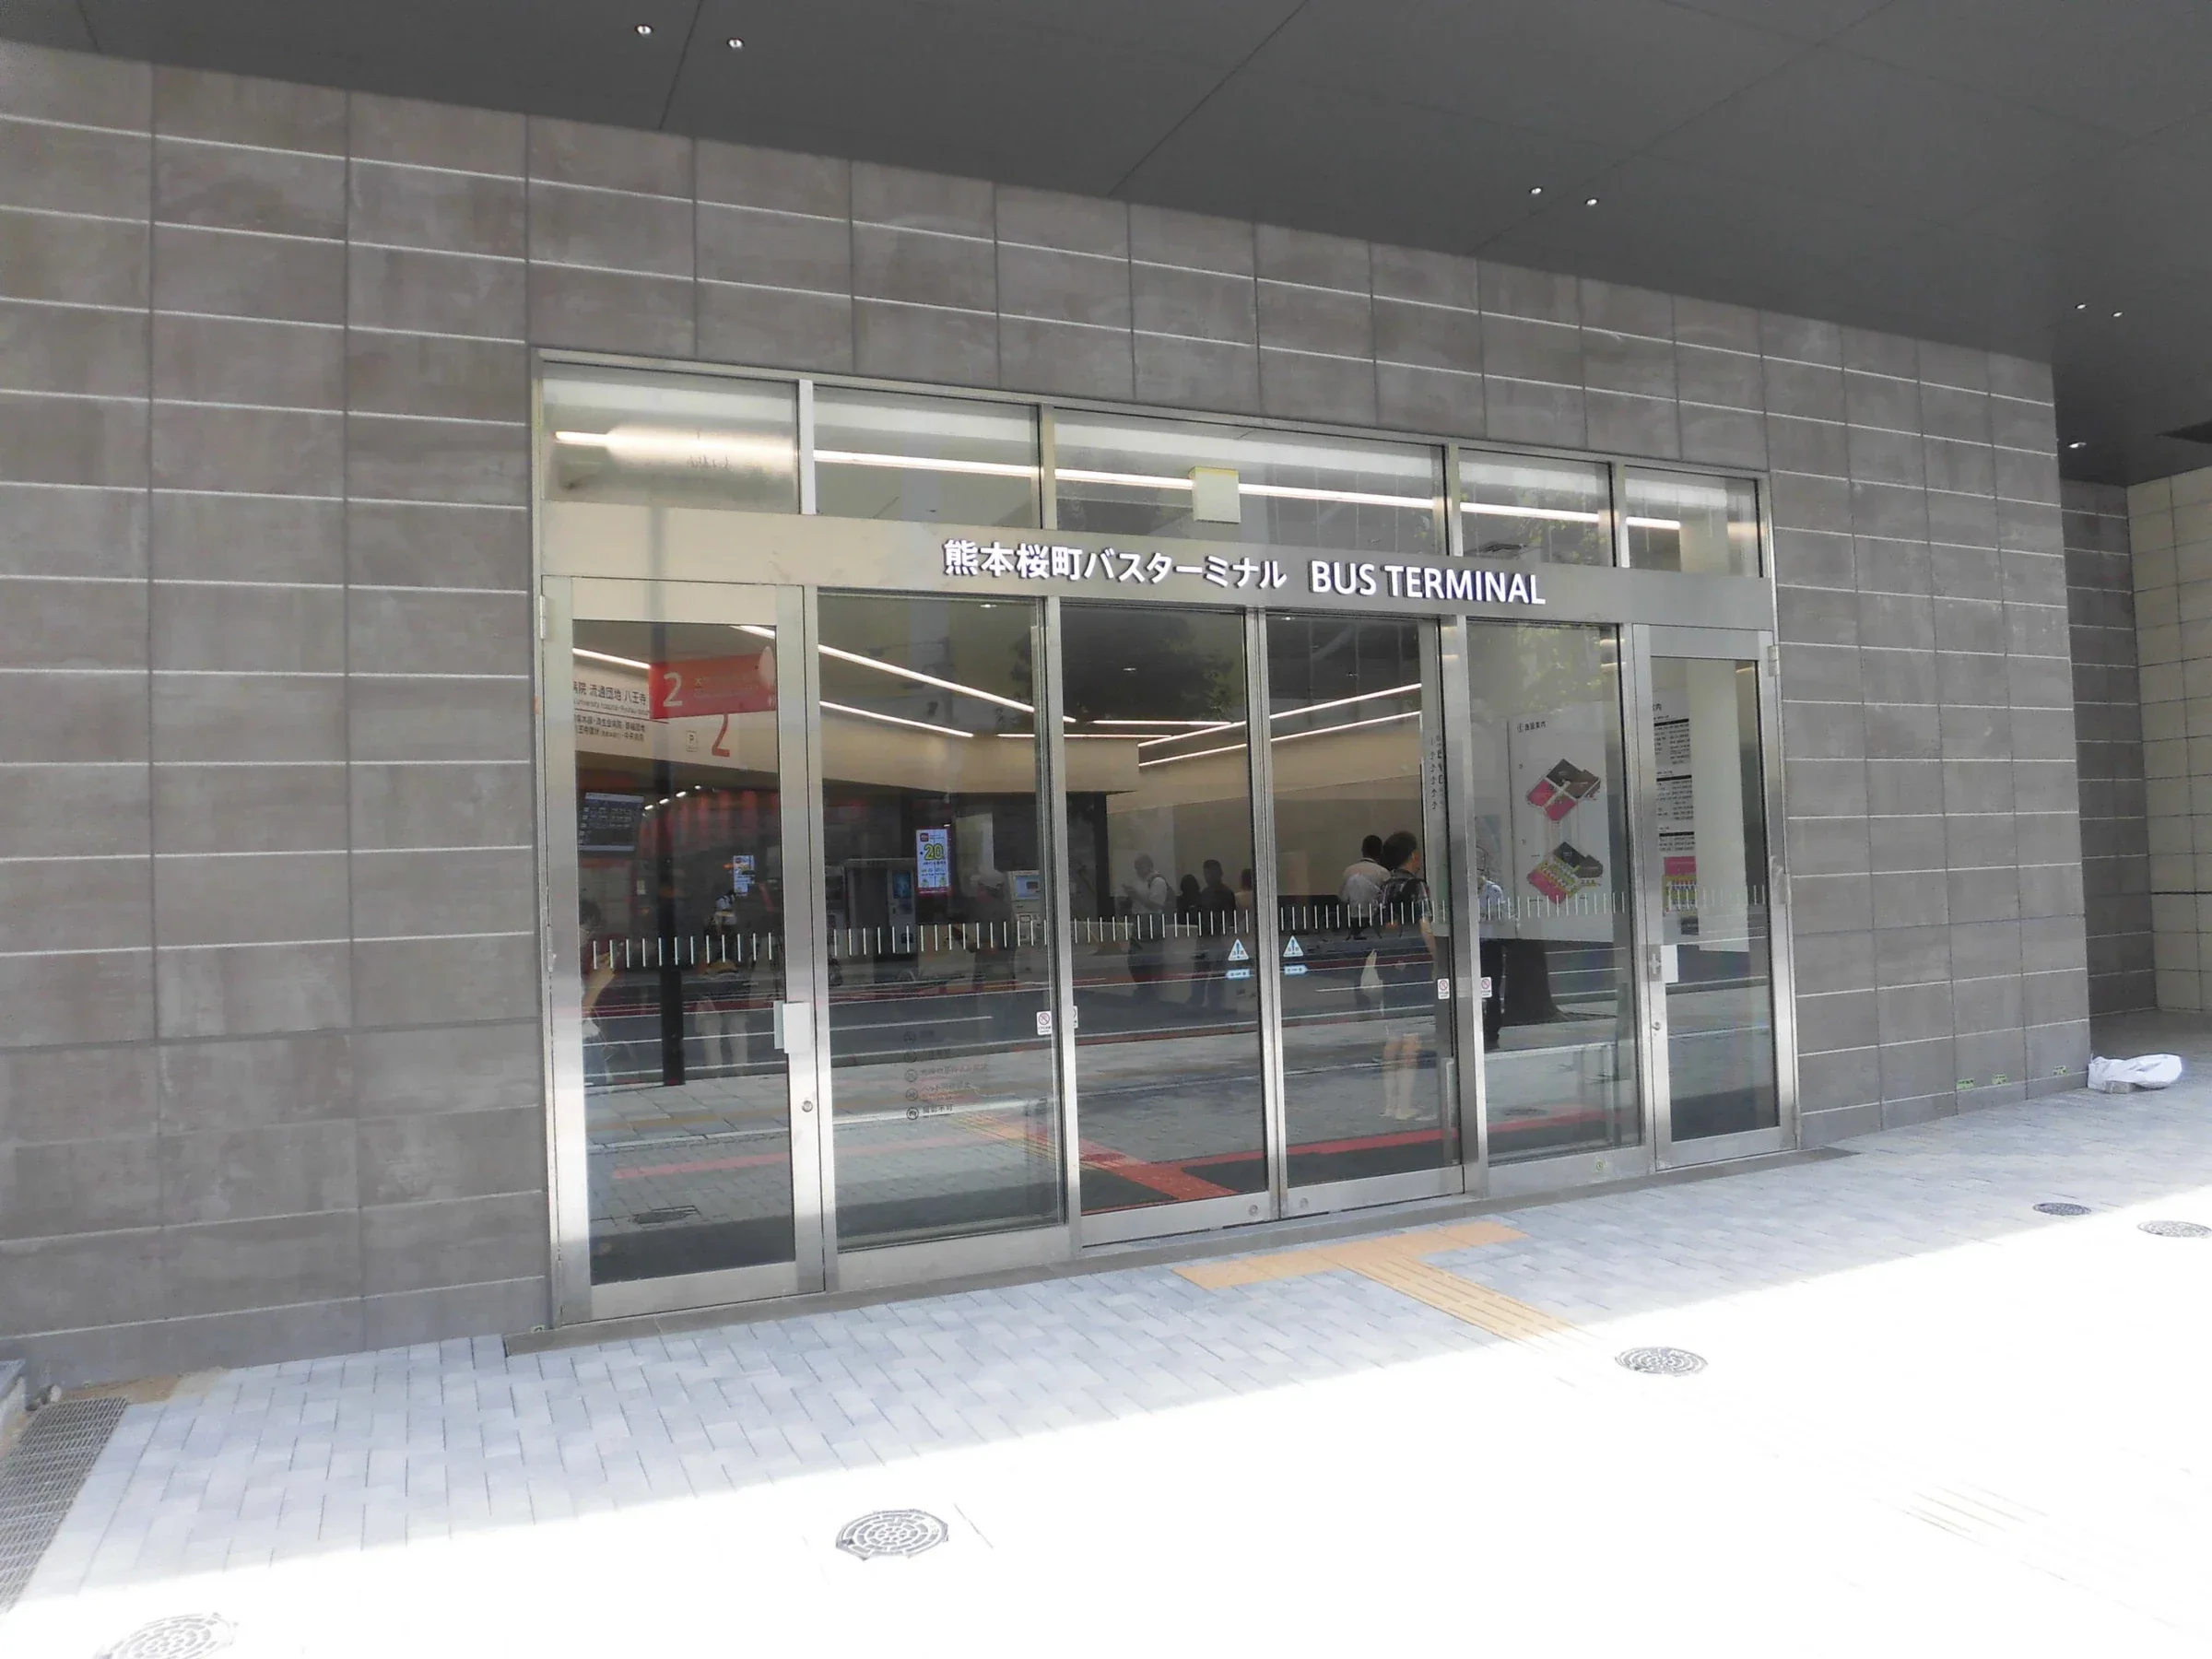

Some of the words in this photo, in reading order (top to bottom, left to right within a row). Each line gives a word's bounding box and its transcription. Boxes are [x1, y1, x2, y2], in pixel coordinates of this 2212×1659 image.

[943, 539, 1287, 588] 熊本桜町バスターミナル
[1311, 560, 1377, 595] BUS
[1383, 565, 1547, 605] TERMINAL
[664, 672, 683, 707] 2
